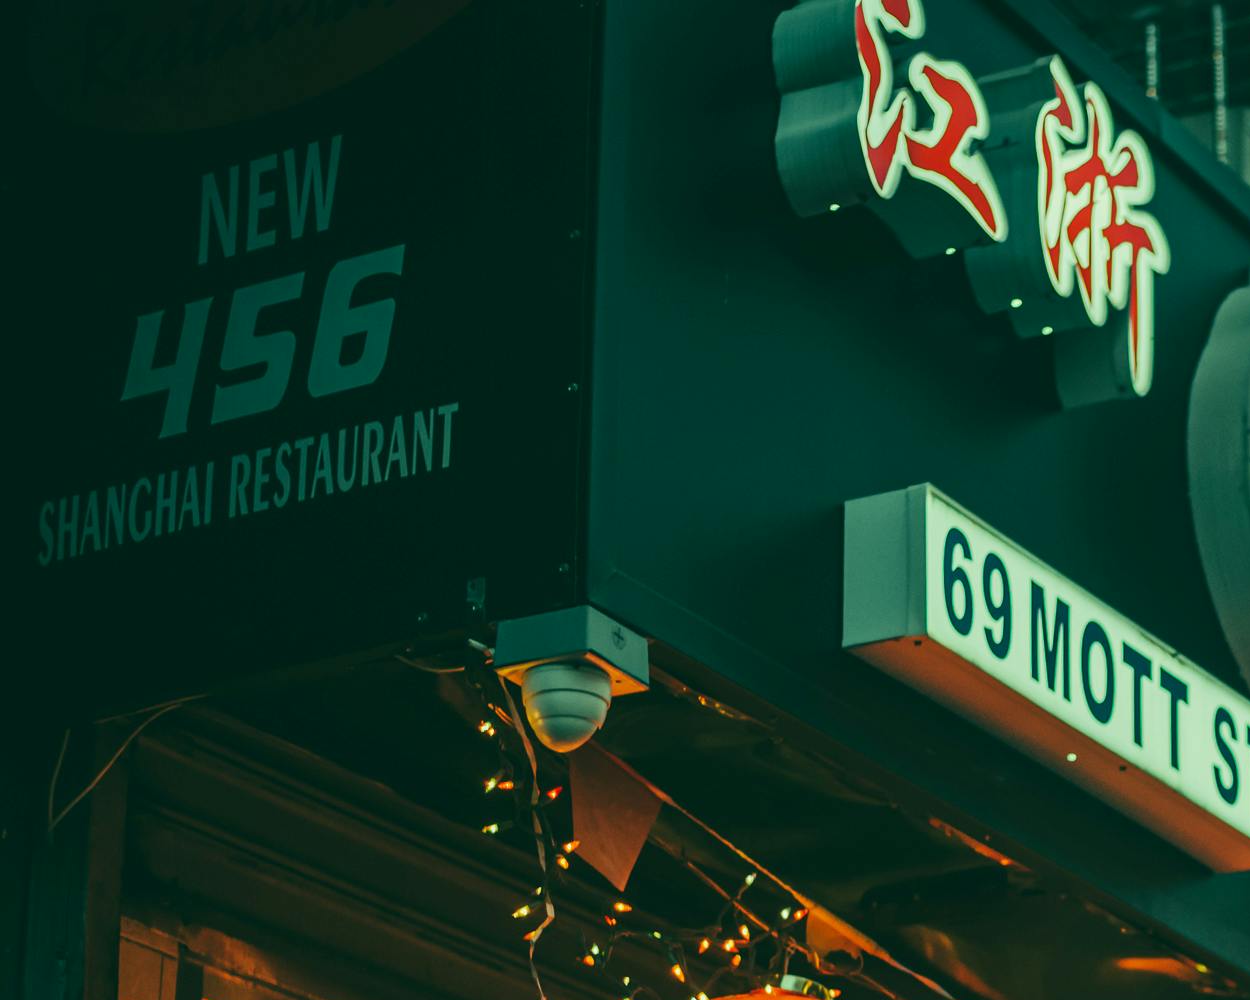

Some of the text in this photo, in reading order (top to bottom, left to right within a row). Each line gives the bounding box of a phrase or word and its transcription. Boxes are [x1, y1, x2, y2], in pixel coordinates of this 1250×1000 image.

[198, 134, 343, 266] NEW
[119, 243, 407, 441] 456
[37, 402, 460, 567] SHANGHAI RESTAURANT
[943, 527, 1012, 661] 69
[1030, 578, 1190, 773] MOTT
